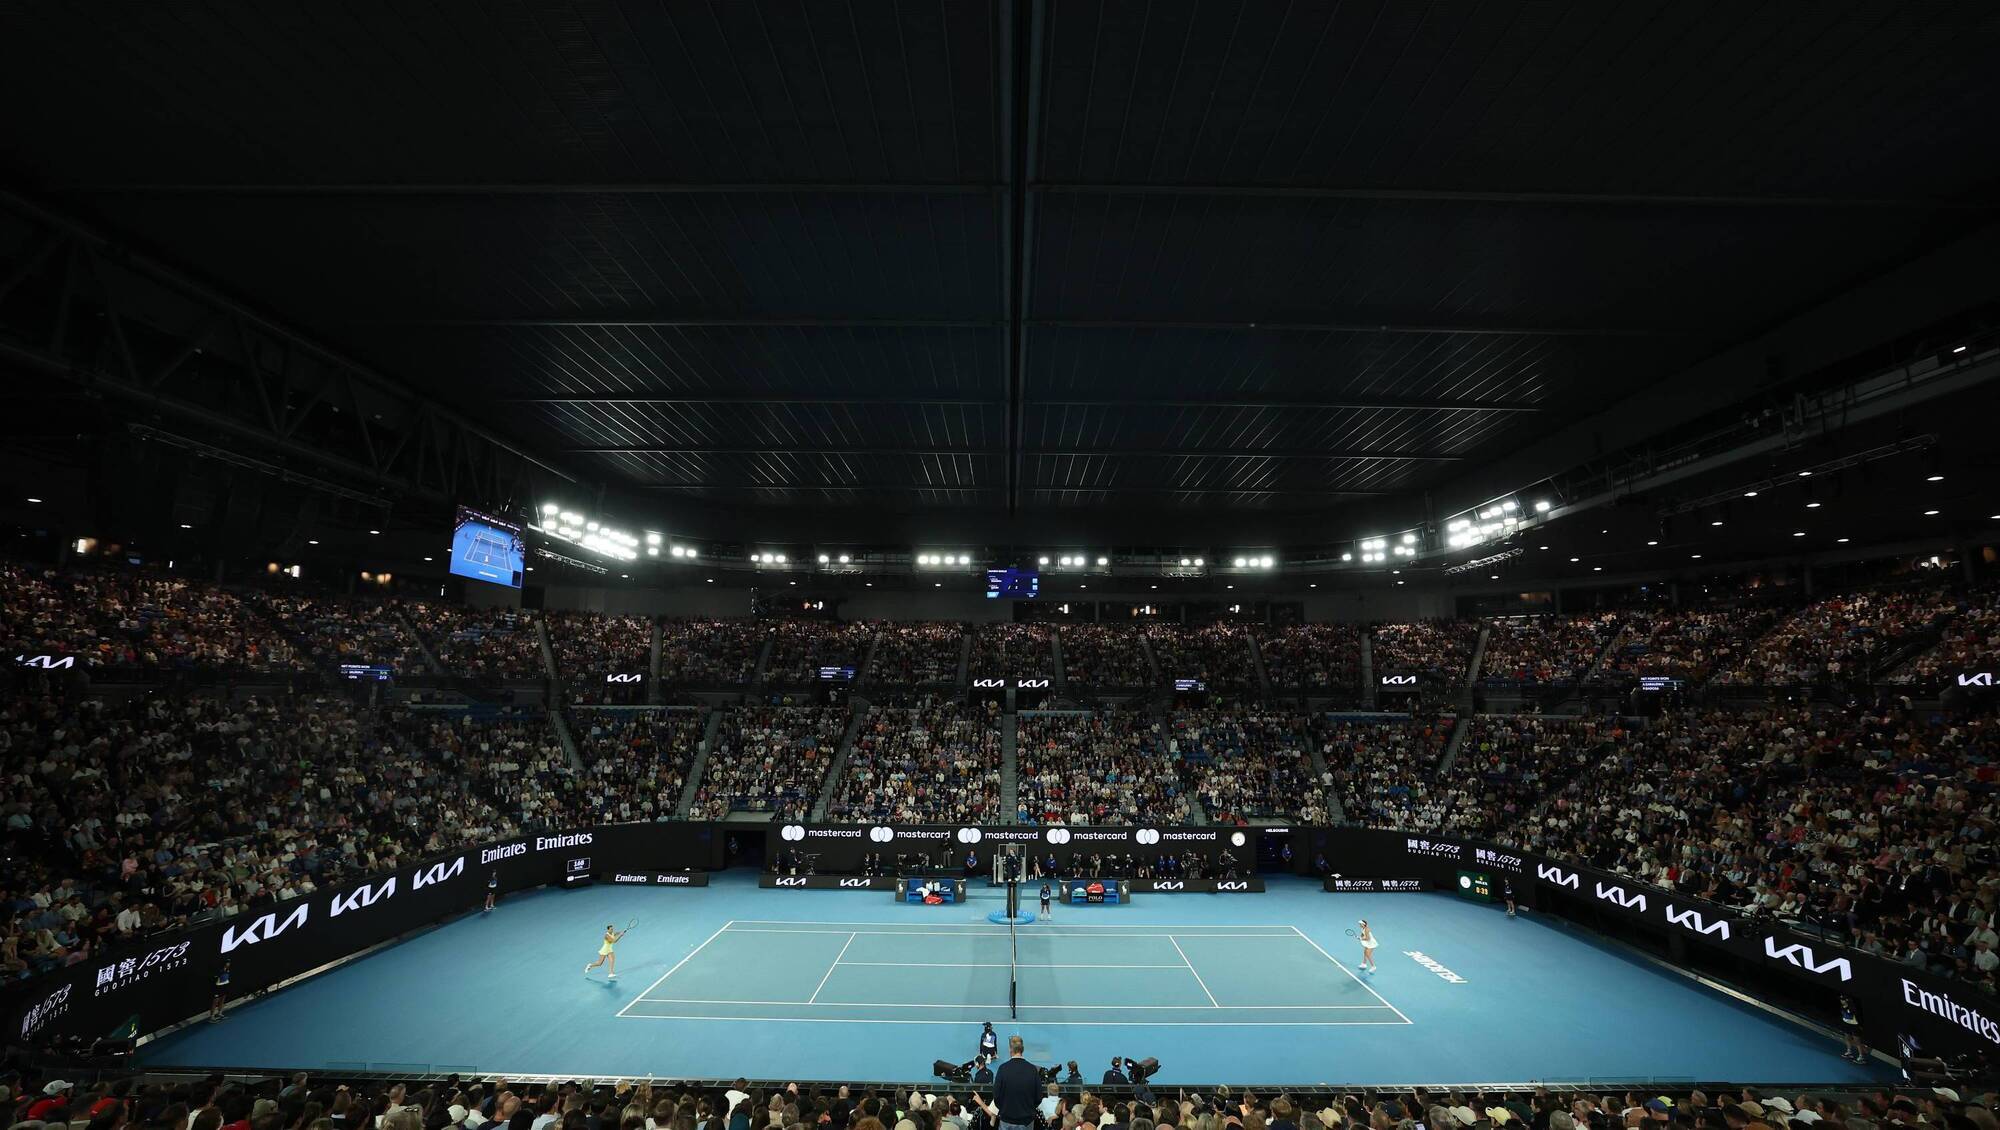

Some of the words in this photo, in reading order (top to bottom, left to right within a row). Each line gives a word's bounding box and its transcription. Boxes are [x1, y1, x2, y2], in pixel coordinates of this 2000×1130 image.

[607, 674, 641, 682] KIA
[974, 679, 1004, 687] KIA
[1018, 679, 1048, 687] KIA
[1383, 676, 1416, 684] KIA
[1958, 673, 1992, 686] KI
[808, 829, 861, 838] mastercard
[897, 830, 951, 839] mastercard
[985, 831, 1038, 840] mastercard
[1074, 832, 1127, 840] mastercard
[1163, 832, 1216, 840] mastercard
[536, 831, 593, 851] Emirates
[481, 841, 527, 864] Emirates
[413, 857, 464, 890] KIA
[615, 873, 647, 883] Emirates
[1538, 863, 1579, 890] KIA
[657, 874, 689, 884] Emirates
[776, 878, 806, 886] KIA
[840, 878, 870, 886] KIA
[1154, 881, 1183, 890] KIA
[1217, 881, 1247, 890] KIA
[331, 877, 396, 917] KIA
[1596, 881, 1646, 912] KIA
[1666, 904, 1729, 941] KIA
[221, 904, 308, 953] KIA
[1765, 936, 1852, 981] KIA
[95, 971, 149, 997] GUOJIAO
[159, 958, 187, 973] 1573
[1901, 977, 2000, 1044] Emirates
